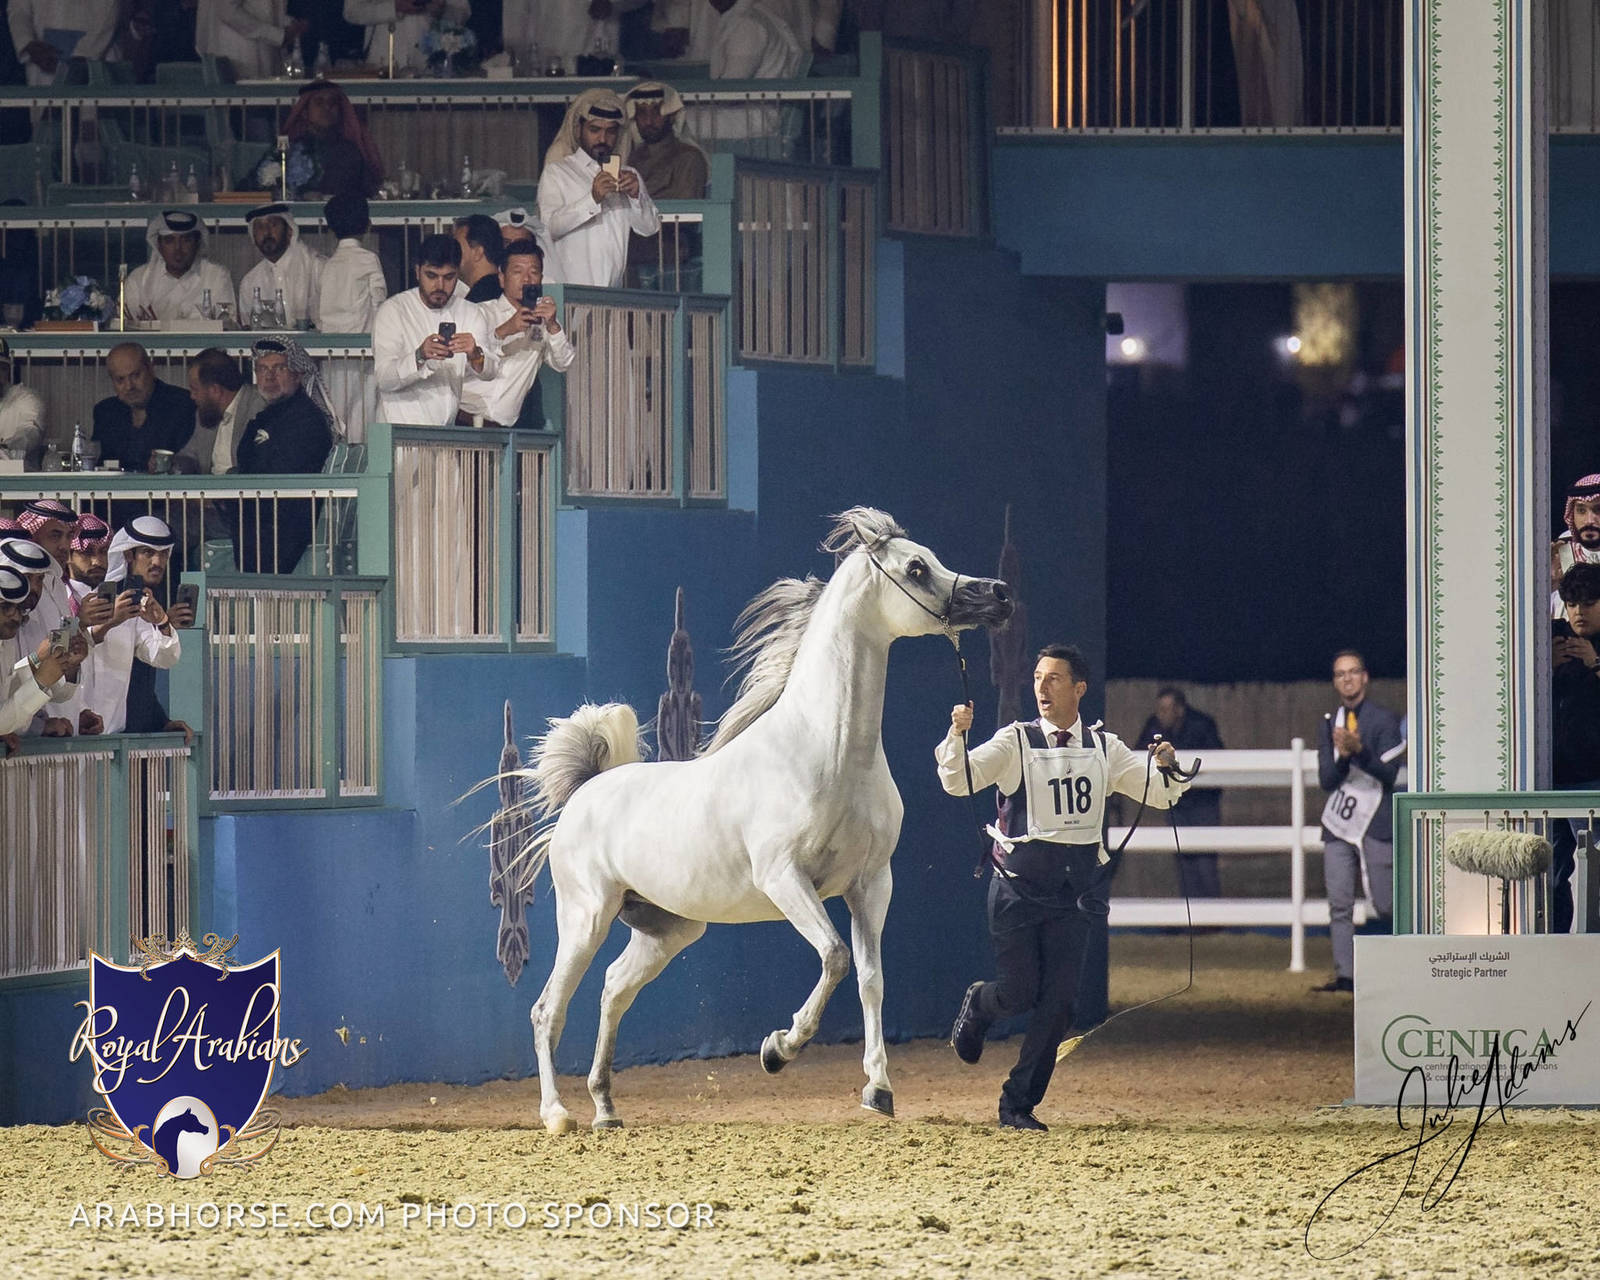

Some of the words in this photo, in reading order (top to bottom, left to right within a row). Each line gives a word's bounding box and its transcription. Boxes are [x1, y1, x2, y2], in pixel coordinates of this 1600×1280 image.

[1047, 776, 1092, 815] 118
[1479, 952, 1509, 963] الشريك
[1431, 967, 1472, 980] Strategic
[1474, 967, 1507, 978] Partner
